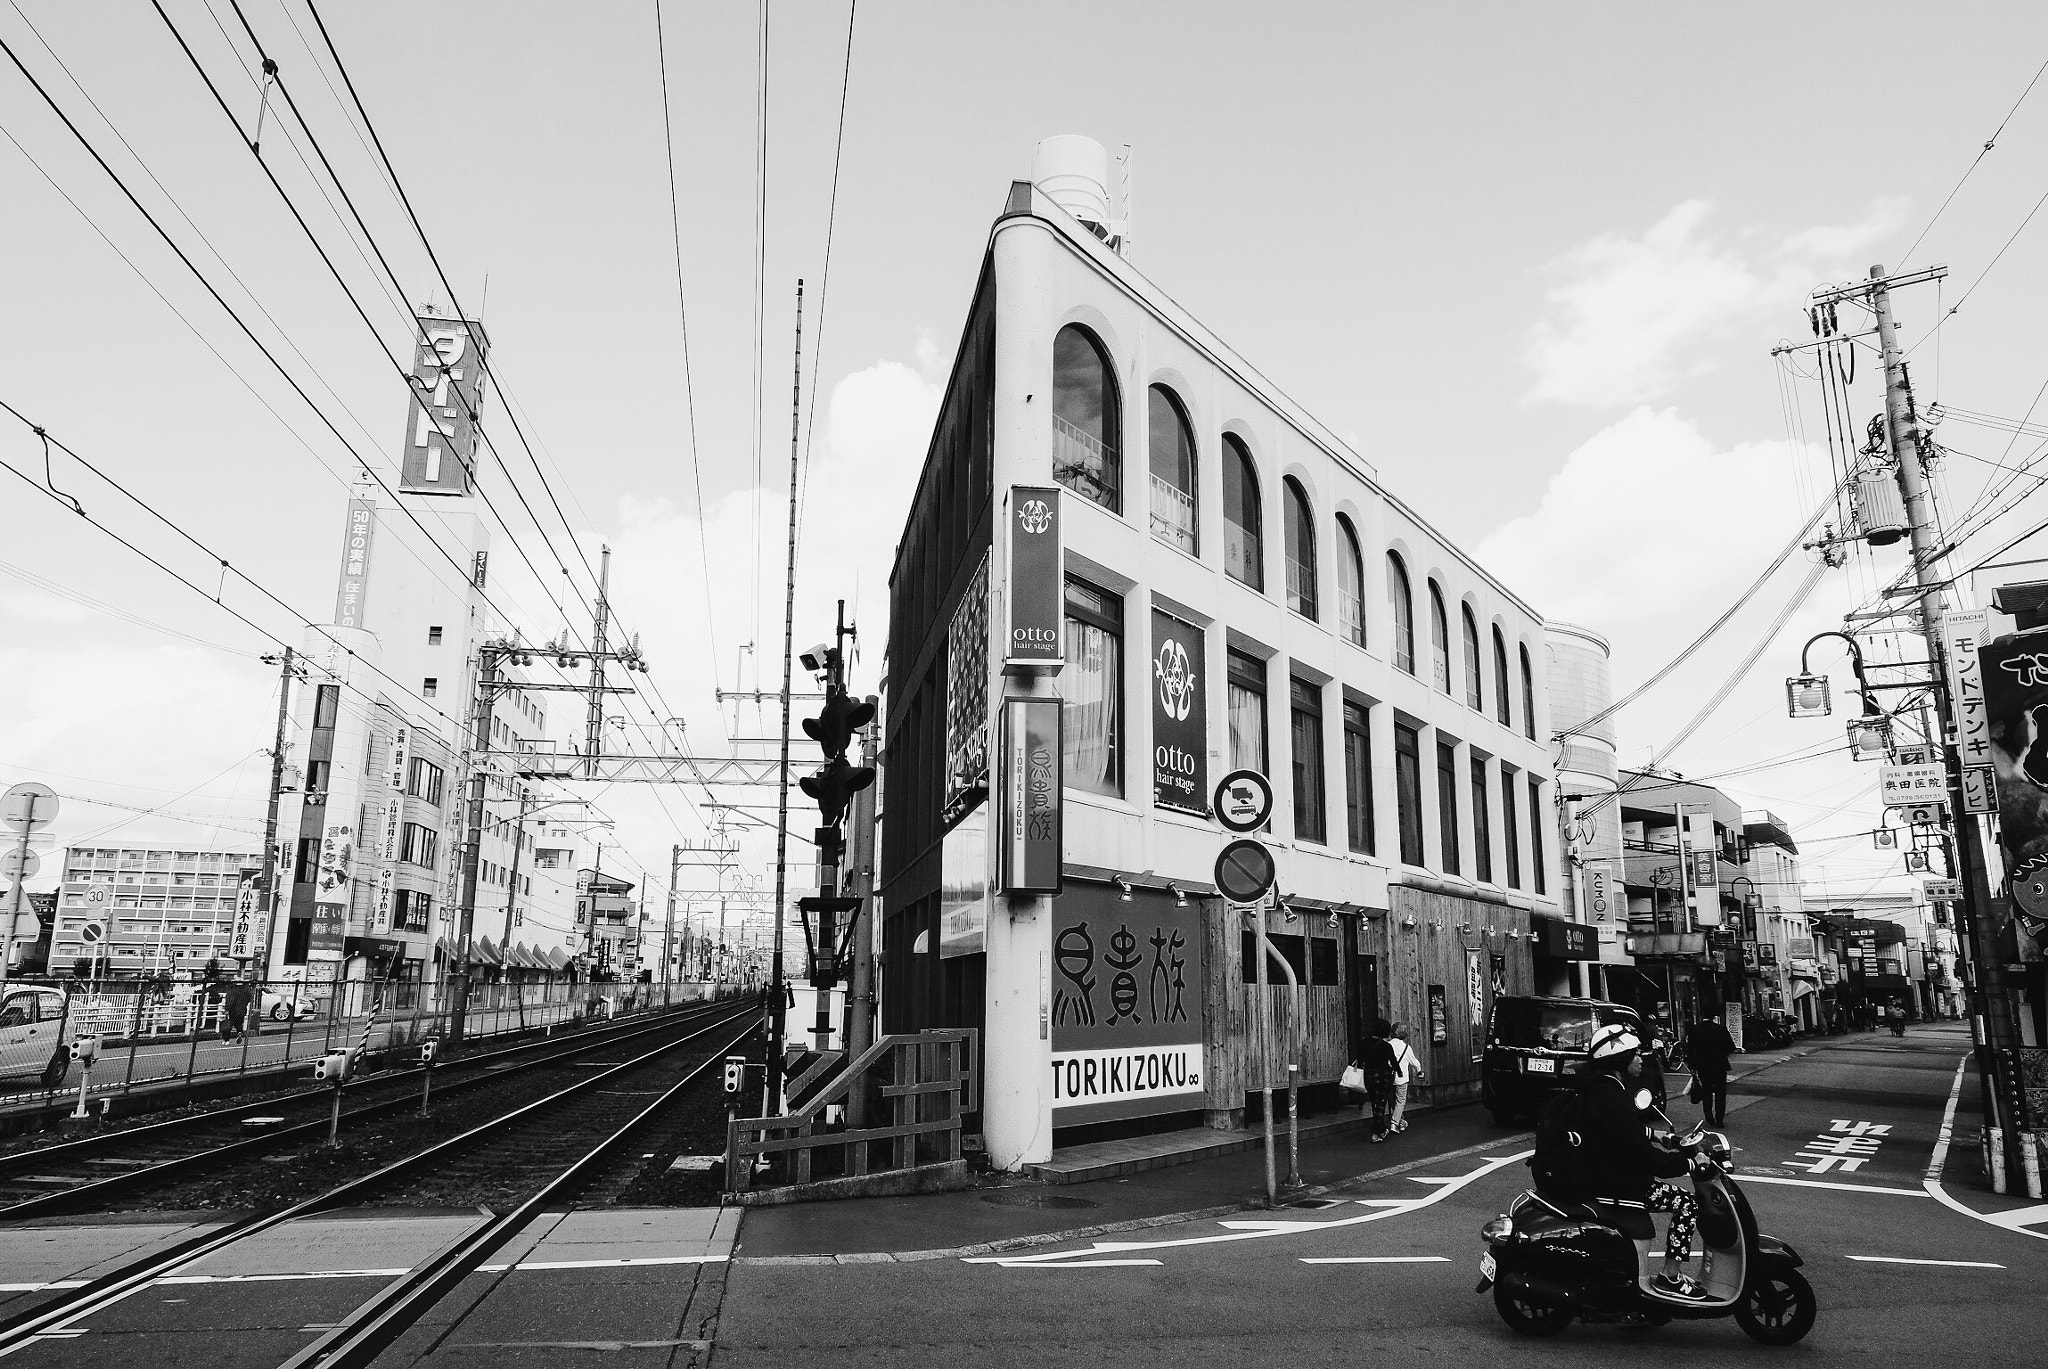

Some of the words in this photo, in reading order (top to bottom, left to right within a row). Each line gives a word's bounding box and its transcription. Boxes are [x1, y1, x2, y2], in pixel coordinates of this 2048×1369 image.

[347, 510, 369, 576] 50年の実績
[1949, 613, 1984, 622] HITACHI
[1013, 627, 1056, 642] otto
[1014, 640, 1031, 649] hair
[1033, 642, 1056, 652] stage
[1955, 637, 1989, 756] モンドデンキ
[966, 719, 988, 768] stage
[1156, 745, 1195, 775] otto
[1156, 767, 1174, 786] hair
[1175, 776, 1195, 794] stage
[88, 890, 104, 902] 30
[1593, 872, 1607, 921] KUMON
[1052, 1052, 1187, 1100] TORIKIZOKU
[1534, 1062, 1553, 1072] 12-34
